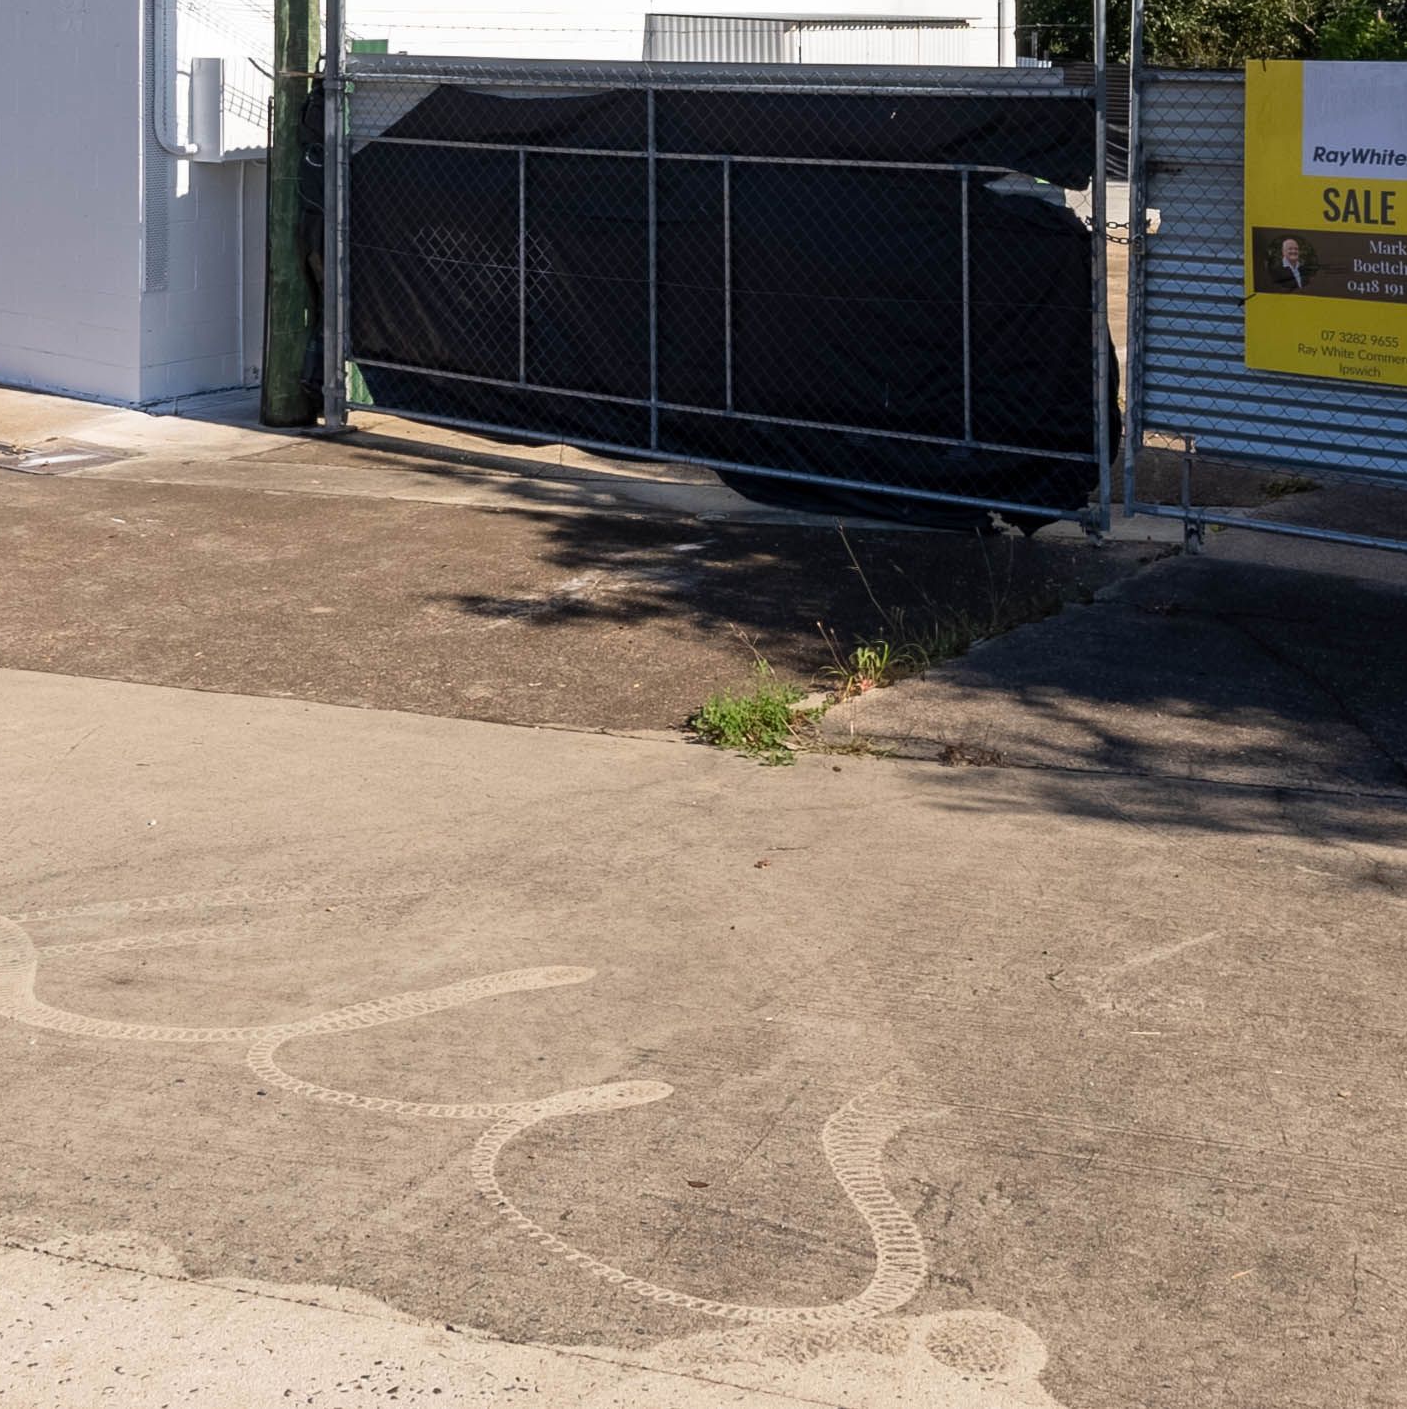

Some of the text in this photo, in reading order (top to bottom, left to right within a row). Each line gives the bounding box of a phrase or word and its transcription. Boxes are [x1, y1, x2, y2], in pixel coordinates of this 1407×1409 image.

[1323, 187, 1396, 225] SALE
[1369, 240, 1407, 256] Mark
[1347, 280, 1380, 294] 0418
[1384, 283, 1405, 296] 191
[1321, 330, 1399, 348] 07 3282 9655
[1298, 343, 1318, 357] Ray
[1321, 345, 1355, 360] White
[1339, 363, 1381, 378] Ipswich
